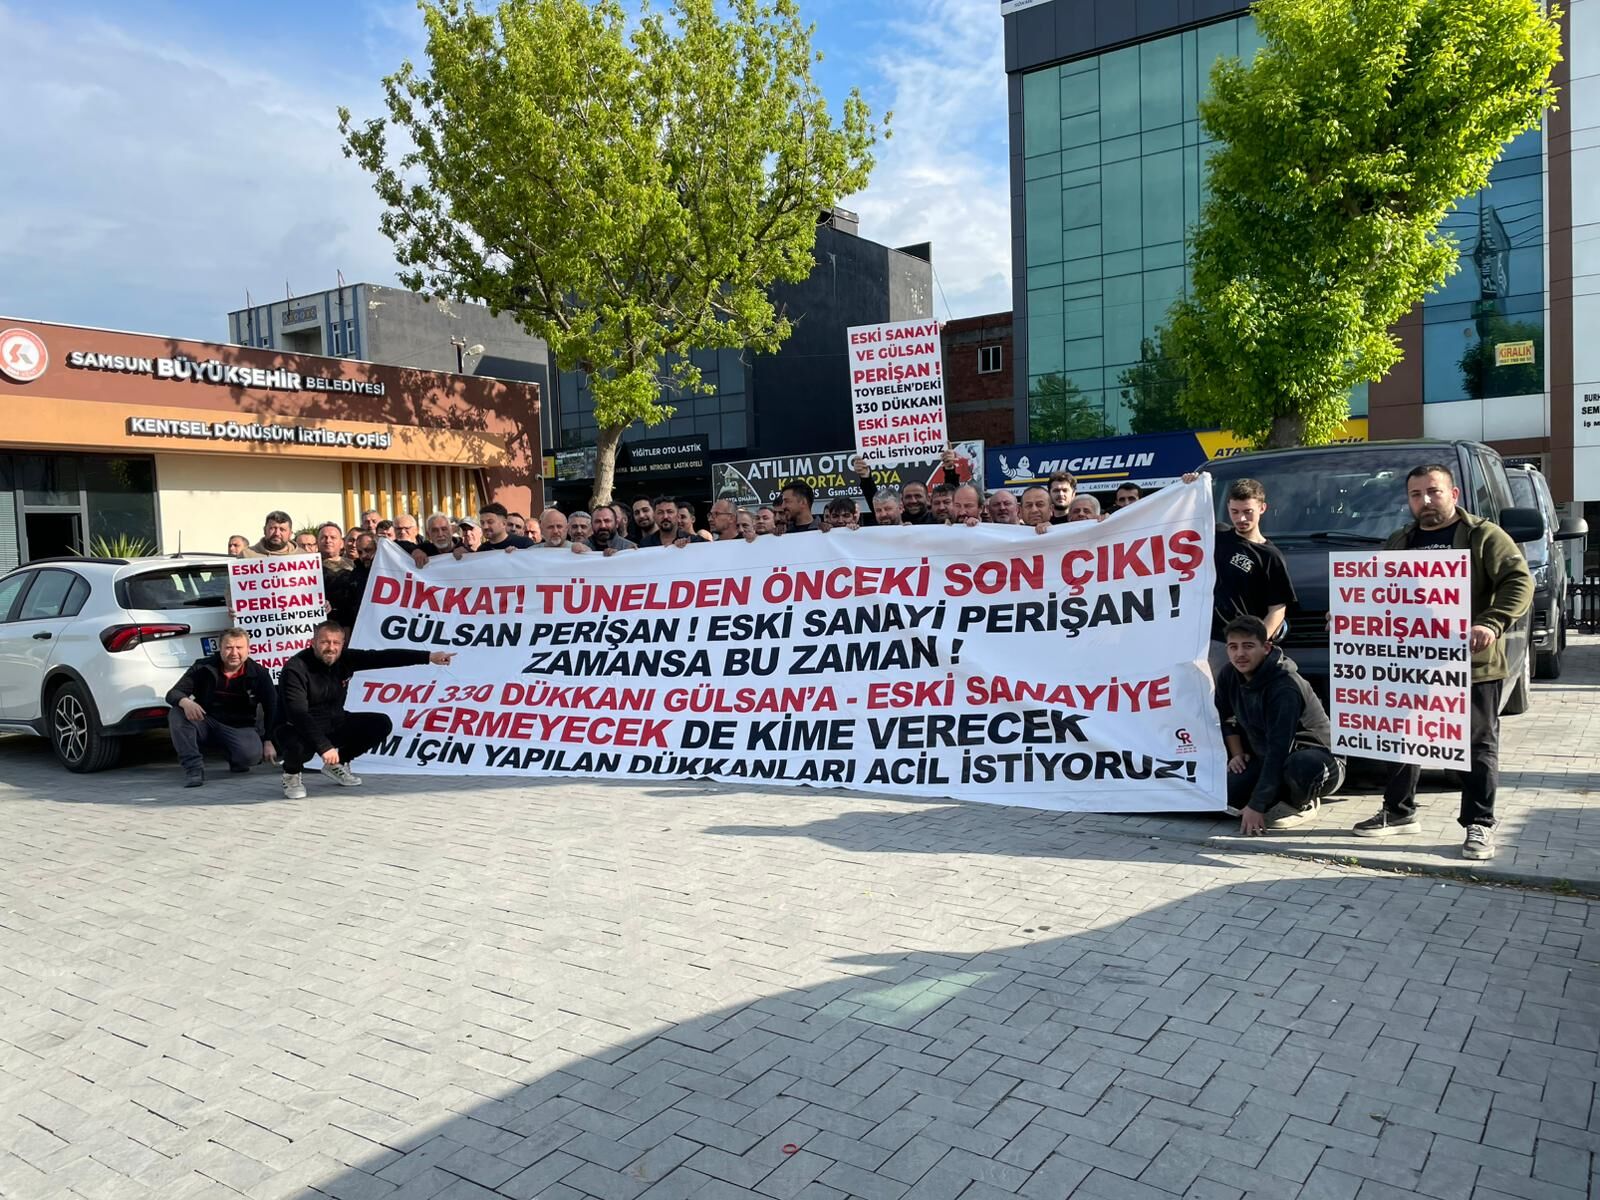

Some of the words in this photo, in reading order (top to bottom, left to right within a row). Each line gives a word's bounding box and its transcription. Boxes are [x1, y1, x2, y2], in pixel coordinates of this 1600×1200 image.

[851, 327, 881, 345] ESKİ
[886, 320, 938, 340] SANAYİ
[856, 350, 874, 361] VE
[878, 342, 934, 359] GÜLSAN
[71, 351, 153, 373] SAMSUN
[157, 356, 302, 389] BÜYÜKŞEHİR
[306, 377, 385, 395] BELEDİYESİ
[853, 362, 930, 384] PERİŞAN
[935, 361, 941, 375] !
[855, 402, 878, 414] 330
[882, 395, 942, 411] DÜKKANI
[858, 414, 888, 430] ESKİ
[891, 408, 943, 427] SANAYİ
[131, 418, 212, 436] KENTSEL
[214, 420, 294, 440] DÖNÜŞÜM
[299, 427, 353, 446] İRTİBAT
[356, 432, 391, 447] OFİSİ
[862, 432, 910, 447] ESNAFI
[913, 427, 942, 444] İÇİN
[662, 446, 676, 454] OTO
[678, 443, 702, 453] LASTİK
[862, 447, 886, 460] ACİL
[889, 444, 944, 459] İSTİYORUZ
[747, 457, 813, 480] ATILIM
[1038, 452, 1155, 473] MICHELIN
[871, 470, 901, 484] OYA
[232, 560, 264, 576] ESKİ
[268, 556, 320, 574] SANAYİ
[371, 573, 525, 615] DİKKAT!
[536, 576, 751, 614] TÜNELDEN
[762, 557, 930, 604] ÖNCEKİ
[944, 555, 1044, 597] SON
[1061, 530, 1204, 596] ÇIKIŞ
[1333, 556, 1377, 577] ESKİ
[1384, 555, 1467, 577] SANAYİ
[238, 580, 257, 591] VE
[261, 575, 317, 590] GÜLSAN
[1340, 587, 1365, 603] VE
[1372, 583, 1459, 605] GÜLSAN
[236, 592, 313, 612] PERİŞAN
[318, 593, 323, 605] !
[380, 614, 522, 647] GÜLSAN
[529, 614, 680, 650] PERİŞAN
[687, 617, 699, 642] !
[707, 605, 793, 641] ESKİ
[803, 599, 945, 637] SANAYİ
[957, 592, 1155, 638] PERİŞAN
[1169, 584, 1181, 618] !
[1334, 609, 1450, 643] PERİŞAN
[1460, 619, 1467, 640] !
[247, 629, 261, 639] 30
[249, 640, 272, 654] SKİ
[276, 638, 313, 651] SANA
[522, 649, 711, 677] ZAMANSA
[723, 647, 780, 677] BU
[788, 635, 939, 675] ZAMAN
[951, 638, 964, 664] !
[1333, 664, 1366, 680] 330
[1373, 663, 1467, 687] DÜKKANI
[362, 680, 437, 704] TOKİ
[438, 684, 494, 704] 330
[500, 681, 656, 711] DÜKKANI
[867, 673, 954, 709] ESKİ
[966, 675, 1171, 712] SANAYİYE
[1335, 685, 1379, 705] ESKİ
[1385, 692, 1466, 714] SANAYİ
[402, 706, 673, 748] VERMEYECEK
[680, 720, 737, 750] DE
[747, 713, 856, 751] KİME
[867, 709, 1090, 750] VERECEK
[1339, 712, 1410, 735] ESNAFI
[1417, 714, 1462, 742] İÇİN
[1337, 732, 1372, 750] ACİL
[1376, 735, 1465, 762] İSTİYORUZ
[406, 733, 475, 766] İÇİN
[484, 744, 621, 773] YAPILAN
[627, 751, 856, 783] DÜKKANLARI
[864, 751, 949, 785] ACİL
[960, 746, 1197, 784] İSTİYORUZ!
